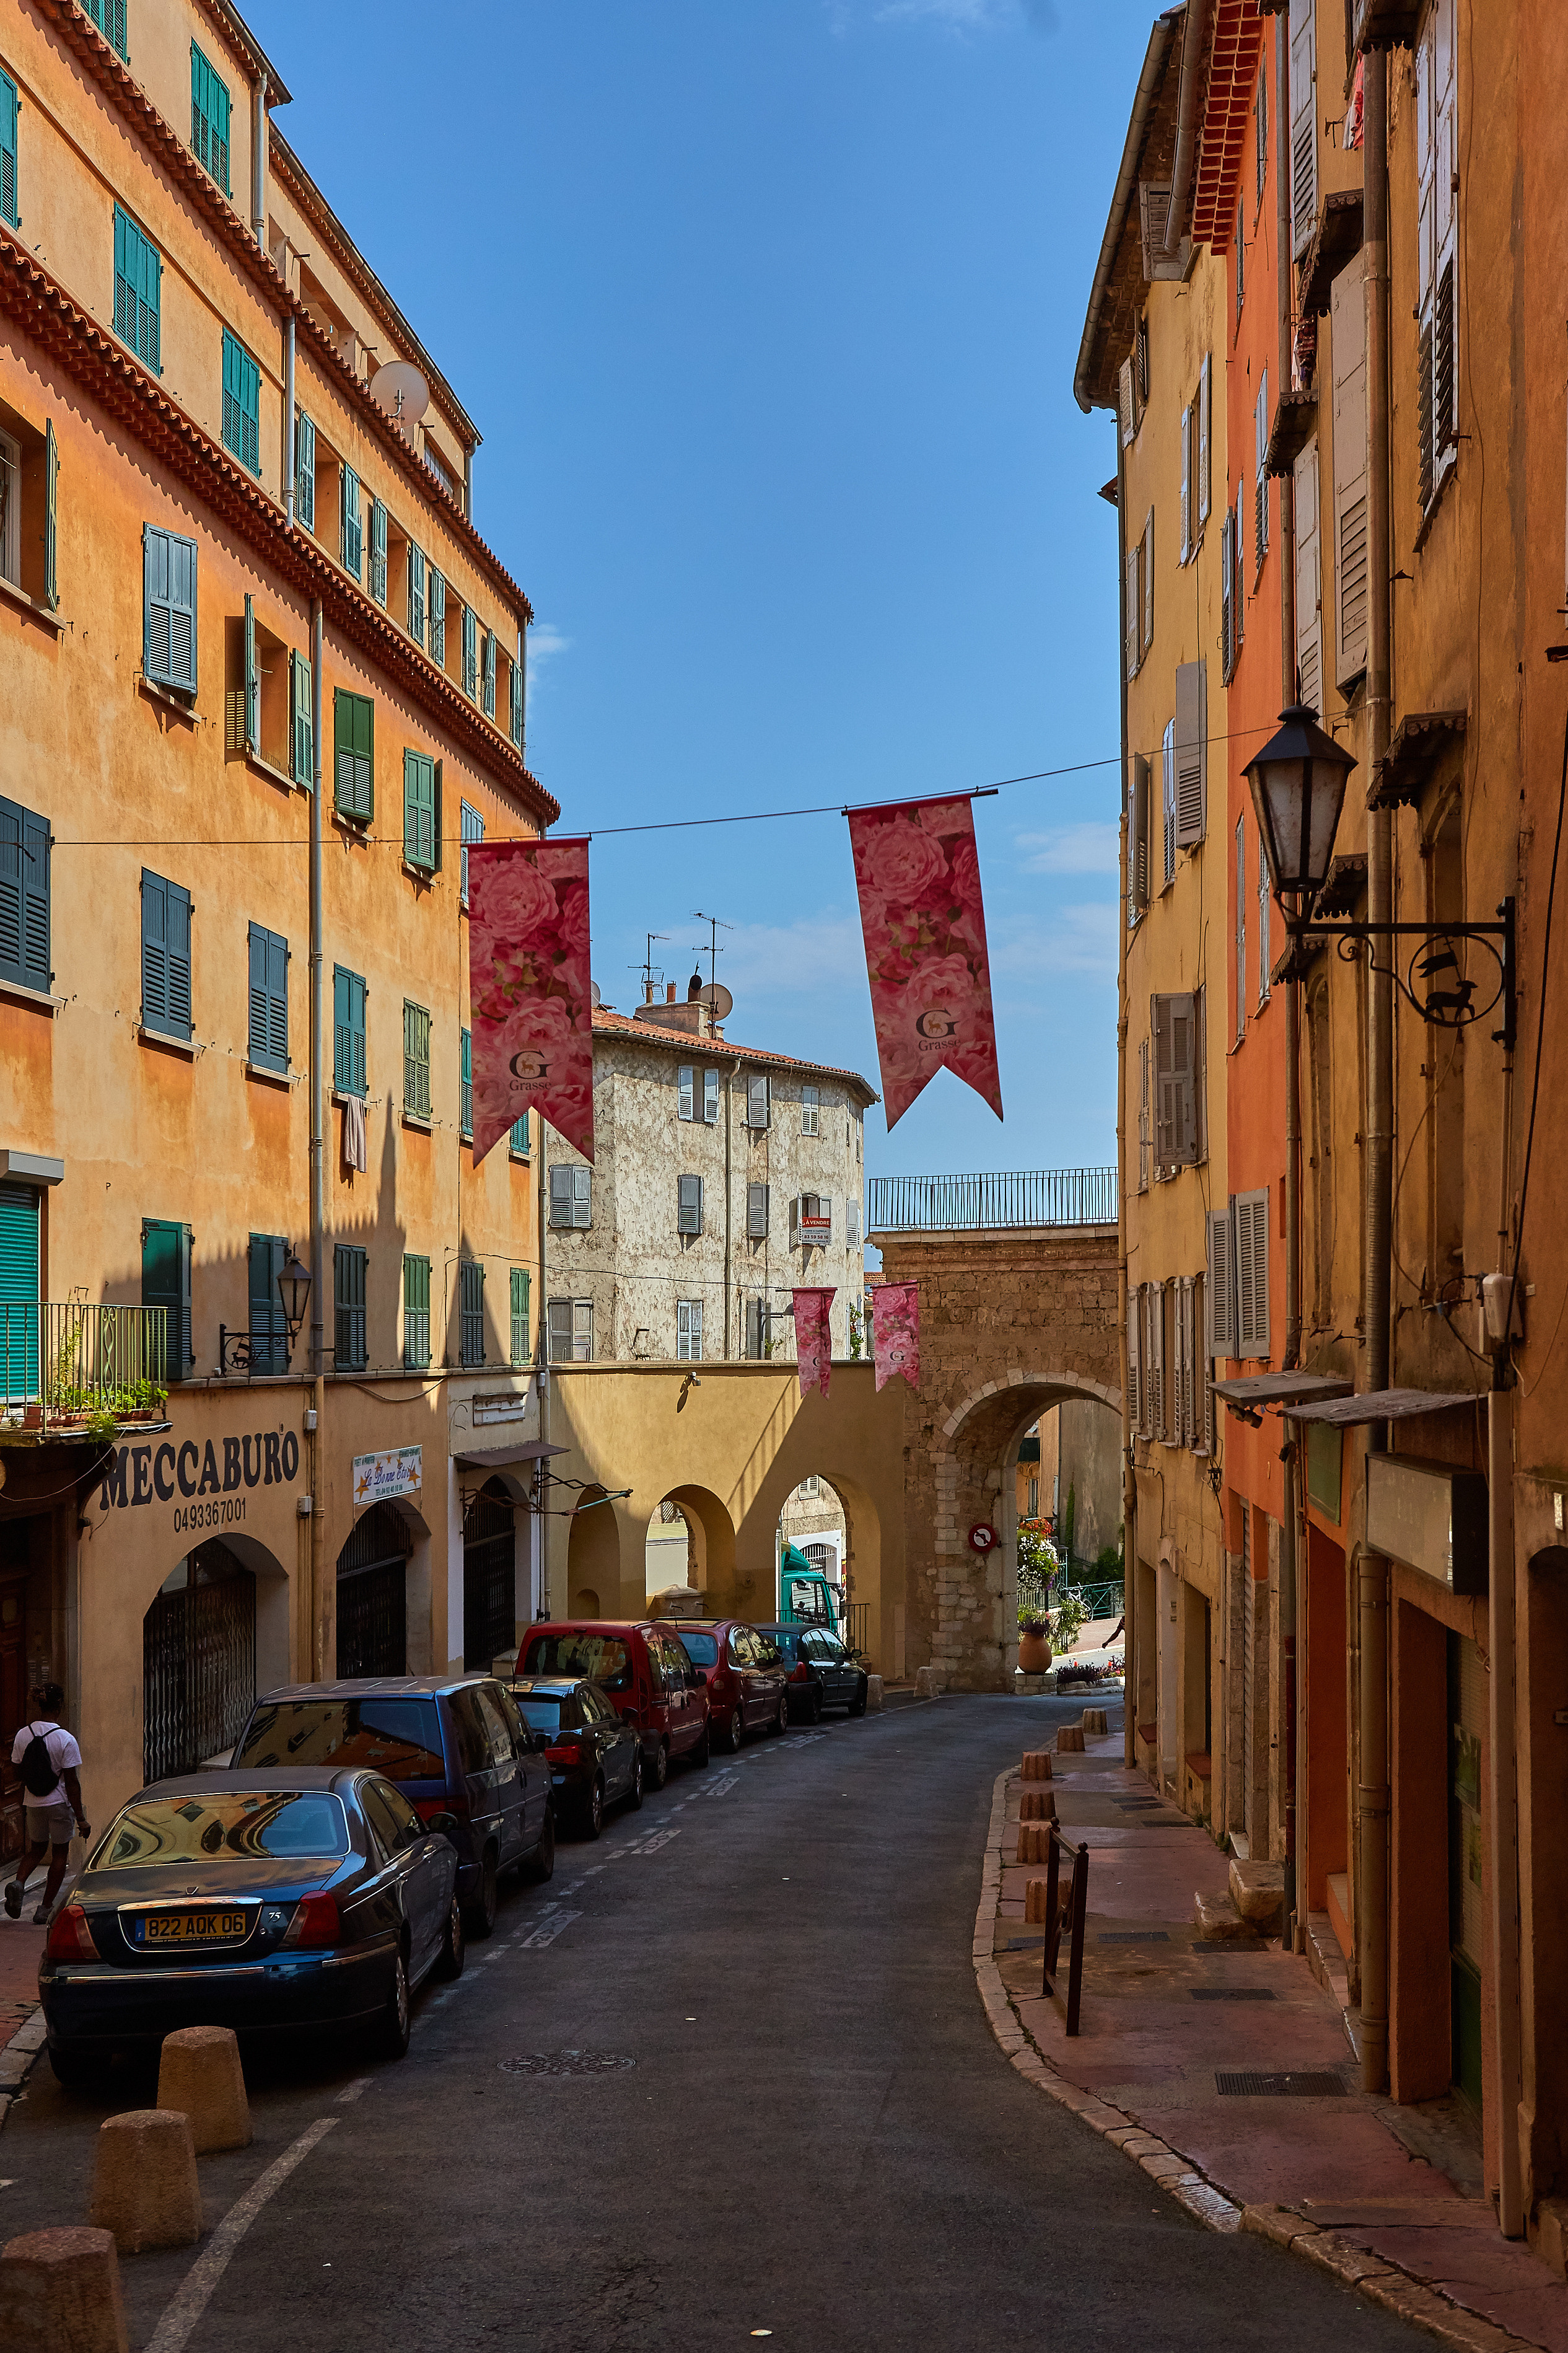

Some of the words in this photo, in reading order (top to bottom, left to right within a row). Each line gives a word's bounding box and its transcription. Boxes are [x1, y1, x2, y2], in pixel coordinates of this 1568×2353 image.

[916, 1007, 960, 1039] G
[918, 1039, 961, 1052] Grasse
[509, 1049, 553, 1079] G
[509, 1079, 551, 1091] Grasse
[99, 1430, 299, 1511] MECCABURO
[374, 1466, 396, 1485] Bonne
[173, 1497, 246, 1533] 0493367001
[149, 1919, 181, 1937] 822
[185, 1915, 217, 1935] AQK
[222, 1914, 243, 1933] 06
[268, 1912, 281, 1922] 75
